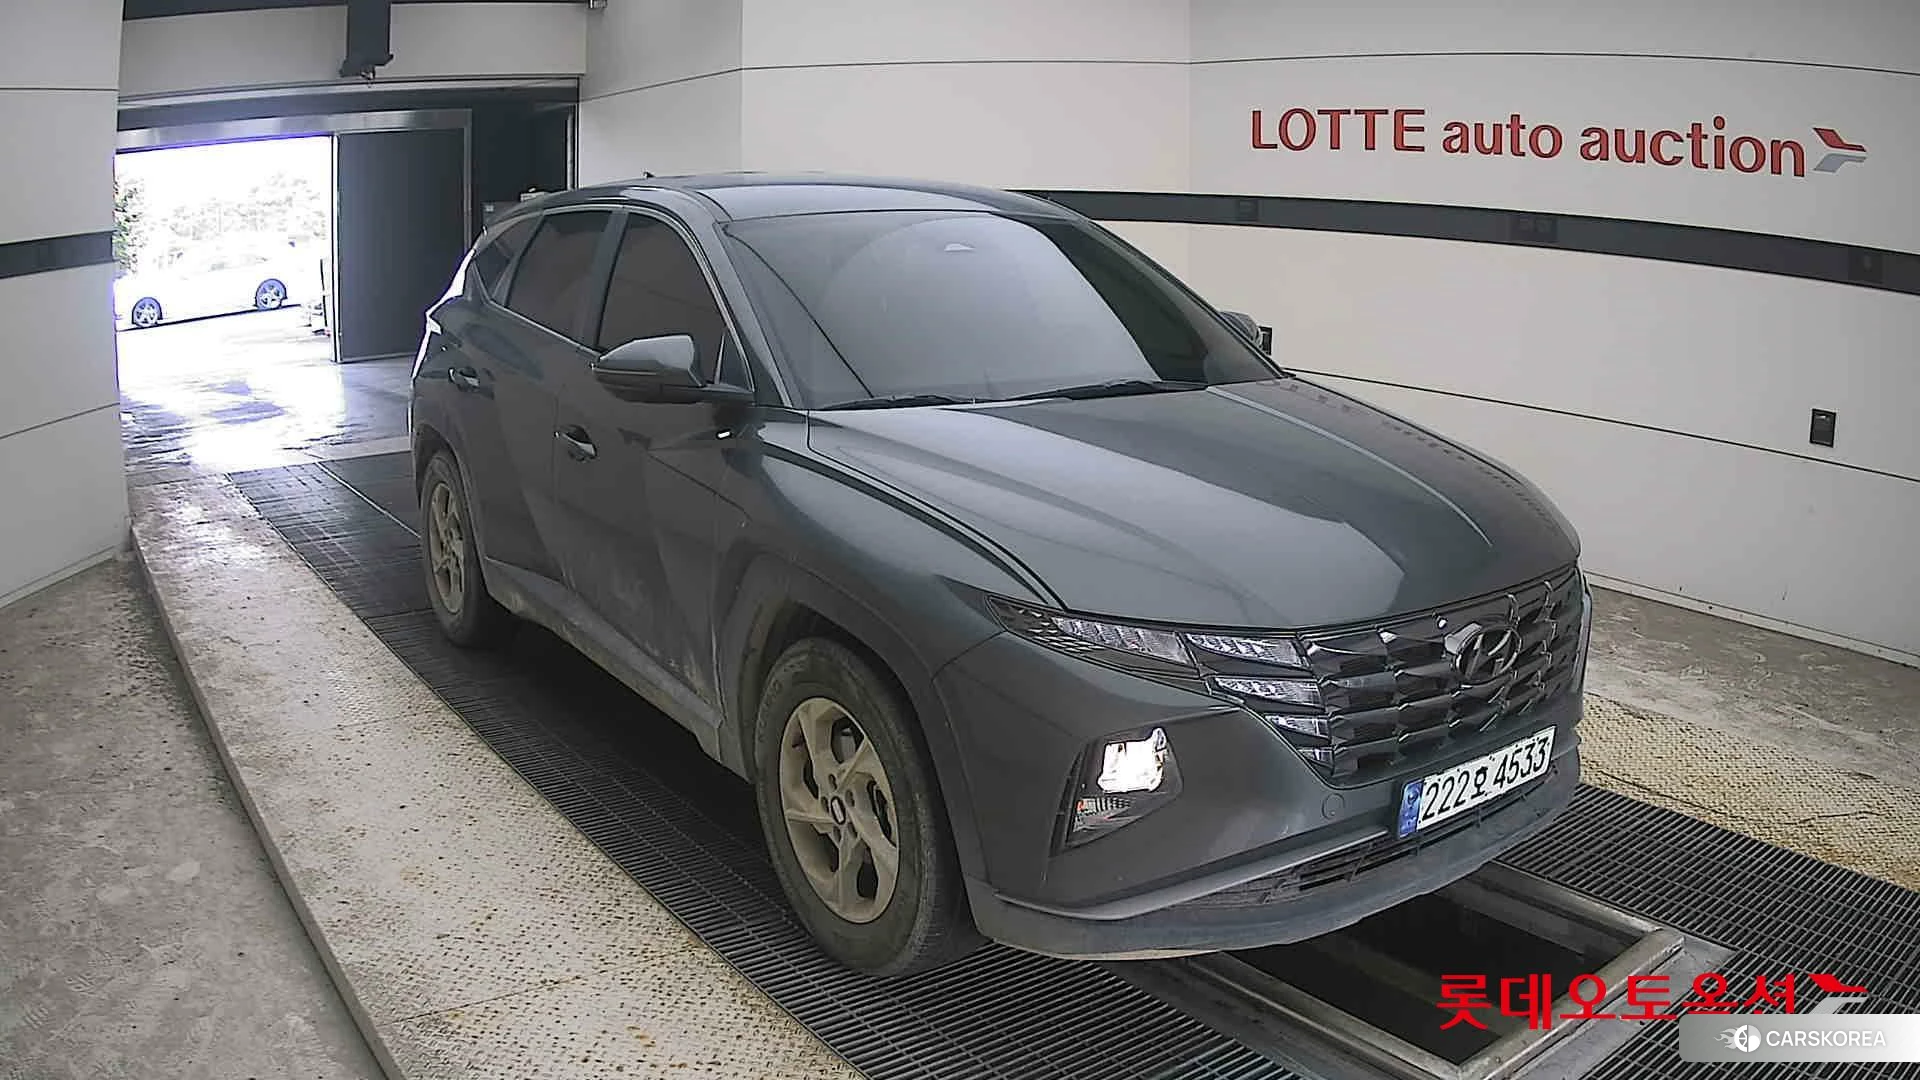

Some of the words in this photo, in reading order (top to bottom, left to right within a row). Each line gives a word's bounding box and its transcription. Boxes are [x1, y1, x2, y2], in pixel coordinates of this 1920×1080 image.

[1251, 108, 1425, 152] LOTTE
[1442, 114, 1563, 158] auto
[1579, 116, 1806, 177] auction
[1493, 737, 1549, 789] 4533
